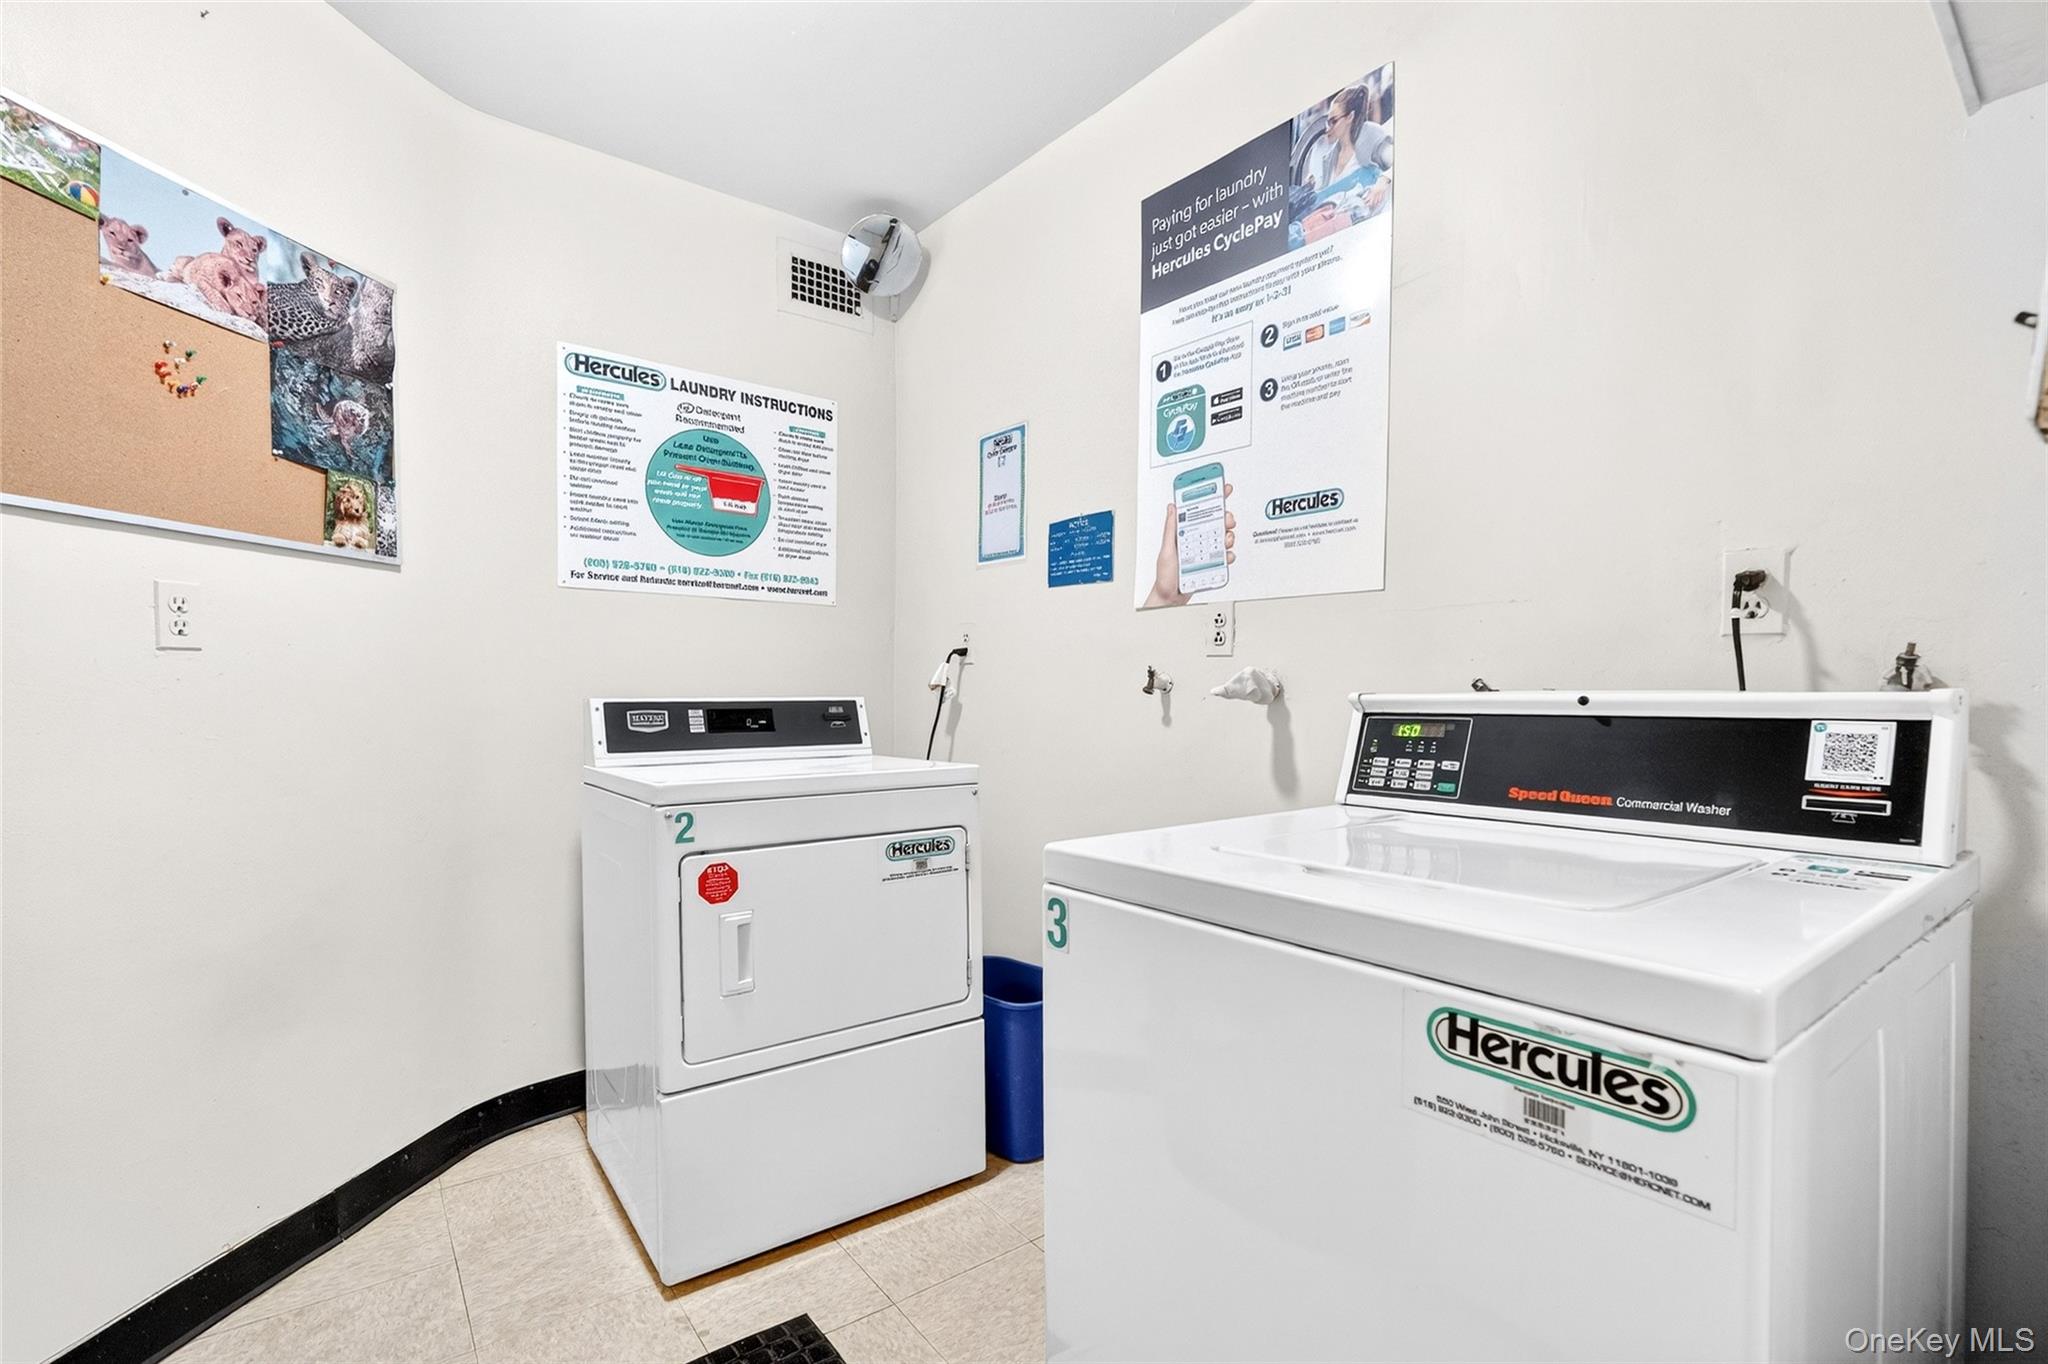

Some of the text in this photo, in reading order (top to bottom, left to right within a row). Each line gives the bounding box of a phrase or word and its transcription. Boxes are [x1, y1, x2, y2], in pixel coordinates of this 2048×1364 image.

[1151, 237, 1172, 261] just
[1175, 224, 1197, 250] got
[1200, 205, 1239, 235] easier
[1252, 182, 1283, 208] with
[1152, 166, 1267, 235] Paying for laundry
[1152, 209, 1283, 280] Hercules CyclePay
[1211, 313, 1223, 323] It's
[1235, 302, 1254, 314] easy
[1266, 285, 1292, 302] 1-2-3!
[574, 353, 833, 422] Hercules LAUNDRY INSTRUCTIONS
[675, 414, 745, 434] Recommended
[696, 406, 741, 421] Detergent
[1271, 491, 1339, 516] Hercules
[570, 570, 585, 579] For
[587, 571, 620, 582] Service
[621, 574, 638, 583] and
[1508, 787, 1732, 817] Speed Queen Commercial Washer
[674, 812, 695, 844] 2
[891, 838, 950, 857] Hercules
[1047, 897, 1067, 949] 3
[1448, 1011, 1671, 1116] Hercules
[1455, 1101, 1478, 1116] West
[1480, 1111, 1501, 1125] John
[1502, 1118, 1531, 1136] Street
[1589, 1149, 1605, 1162] NY
[1576, 1155, 1711, 1211] SERVICE@HERCNET.COM
